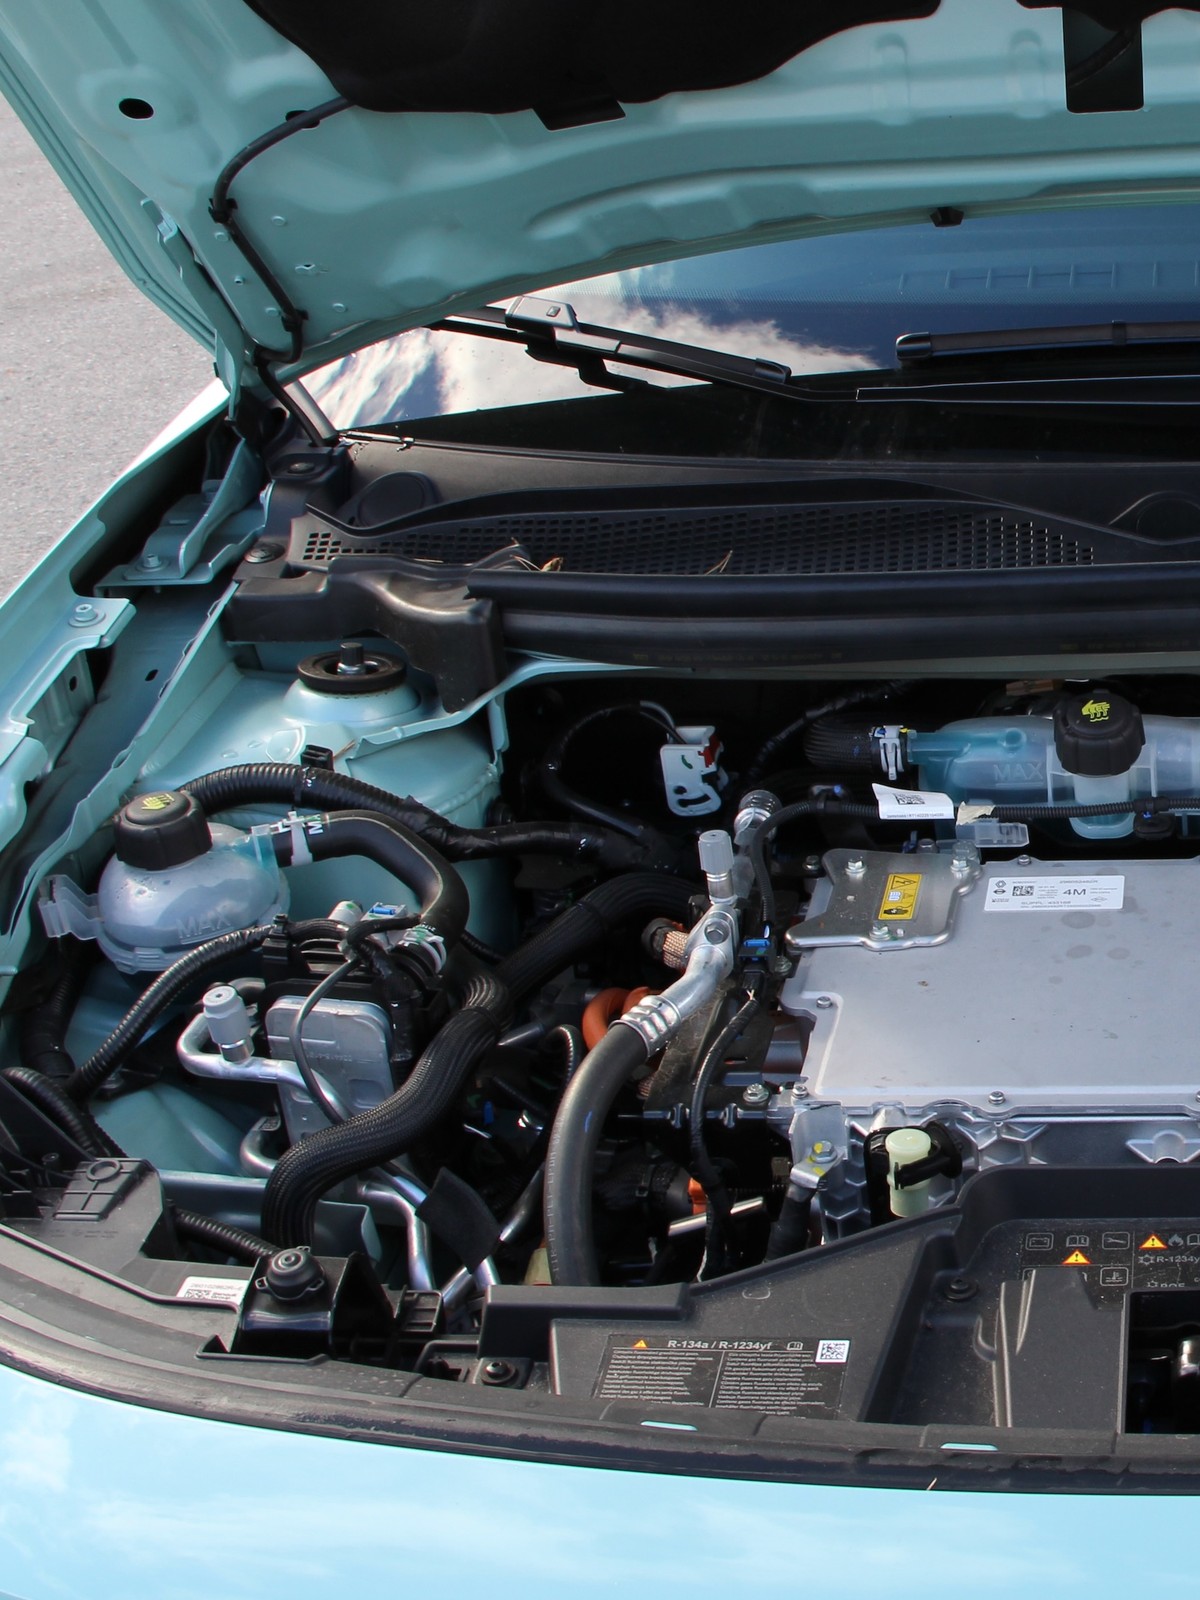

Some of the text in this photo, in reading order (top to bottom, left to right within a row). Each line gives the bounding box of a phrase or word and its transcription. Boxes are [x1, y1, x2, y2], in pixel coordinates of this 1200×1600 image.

[993, 762, 1044, 780] MAX
[1063, 888, 1086, 896] 4M
[176, 911, 232, 938] MAX
[667, 1340, 709, 1348] R-134a
[719, 1341, 773, 1351] R-1234yf
